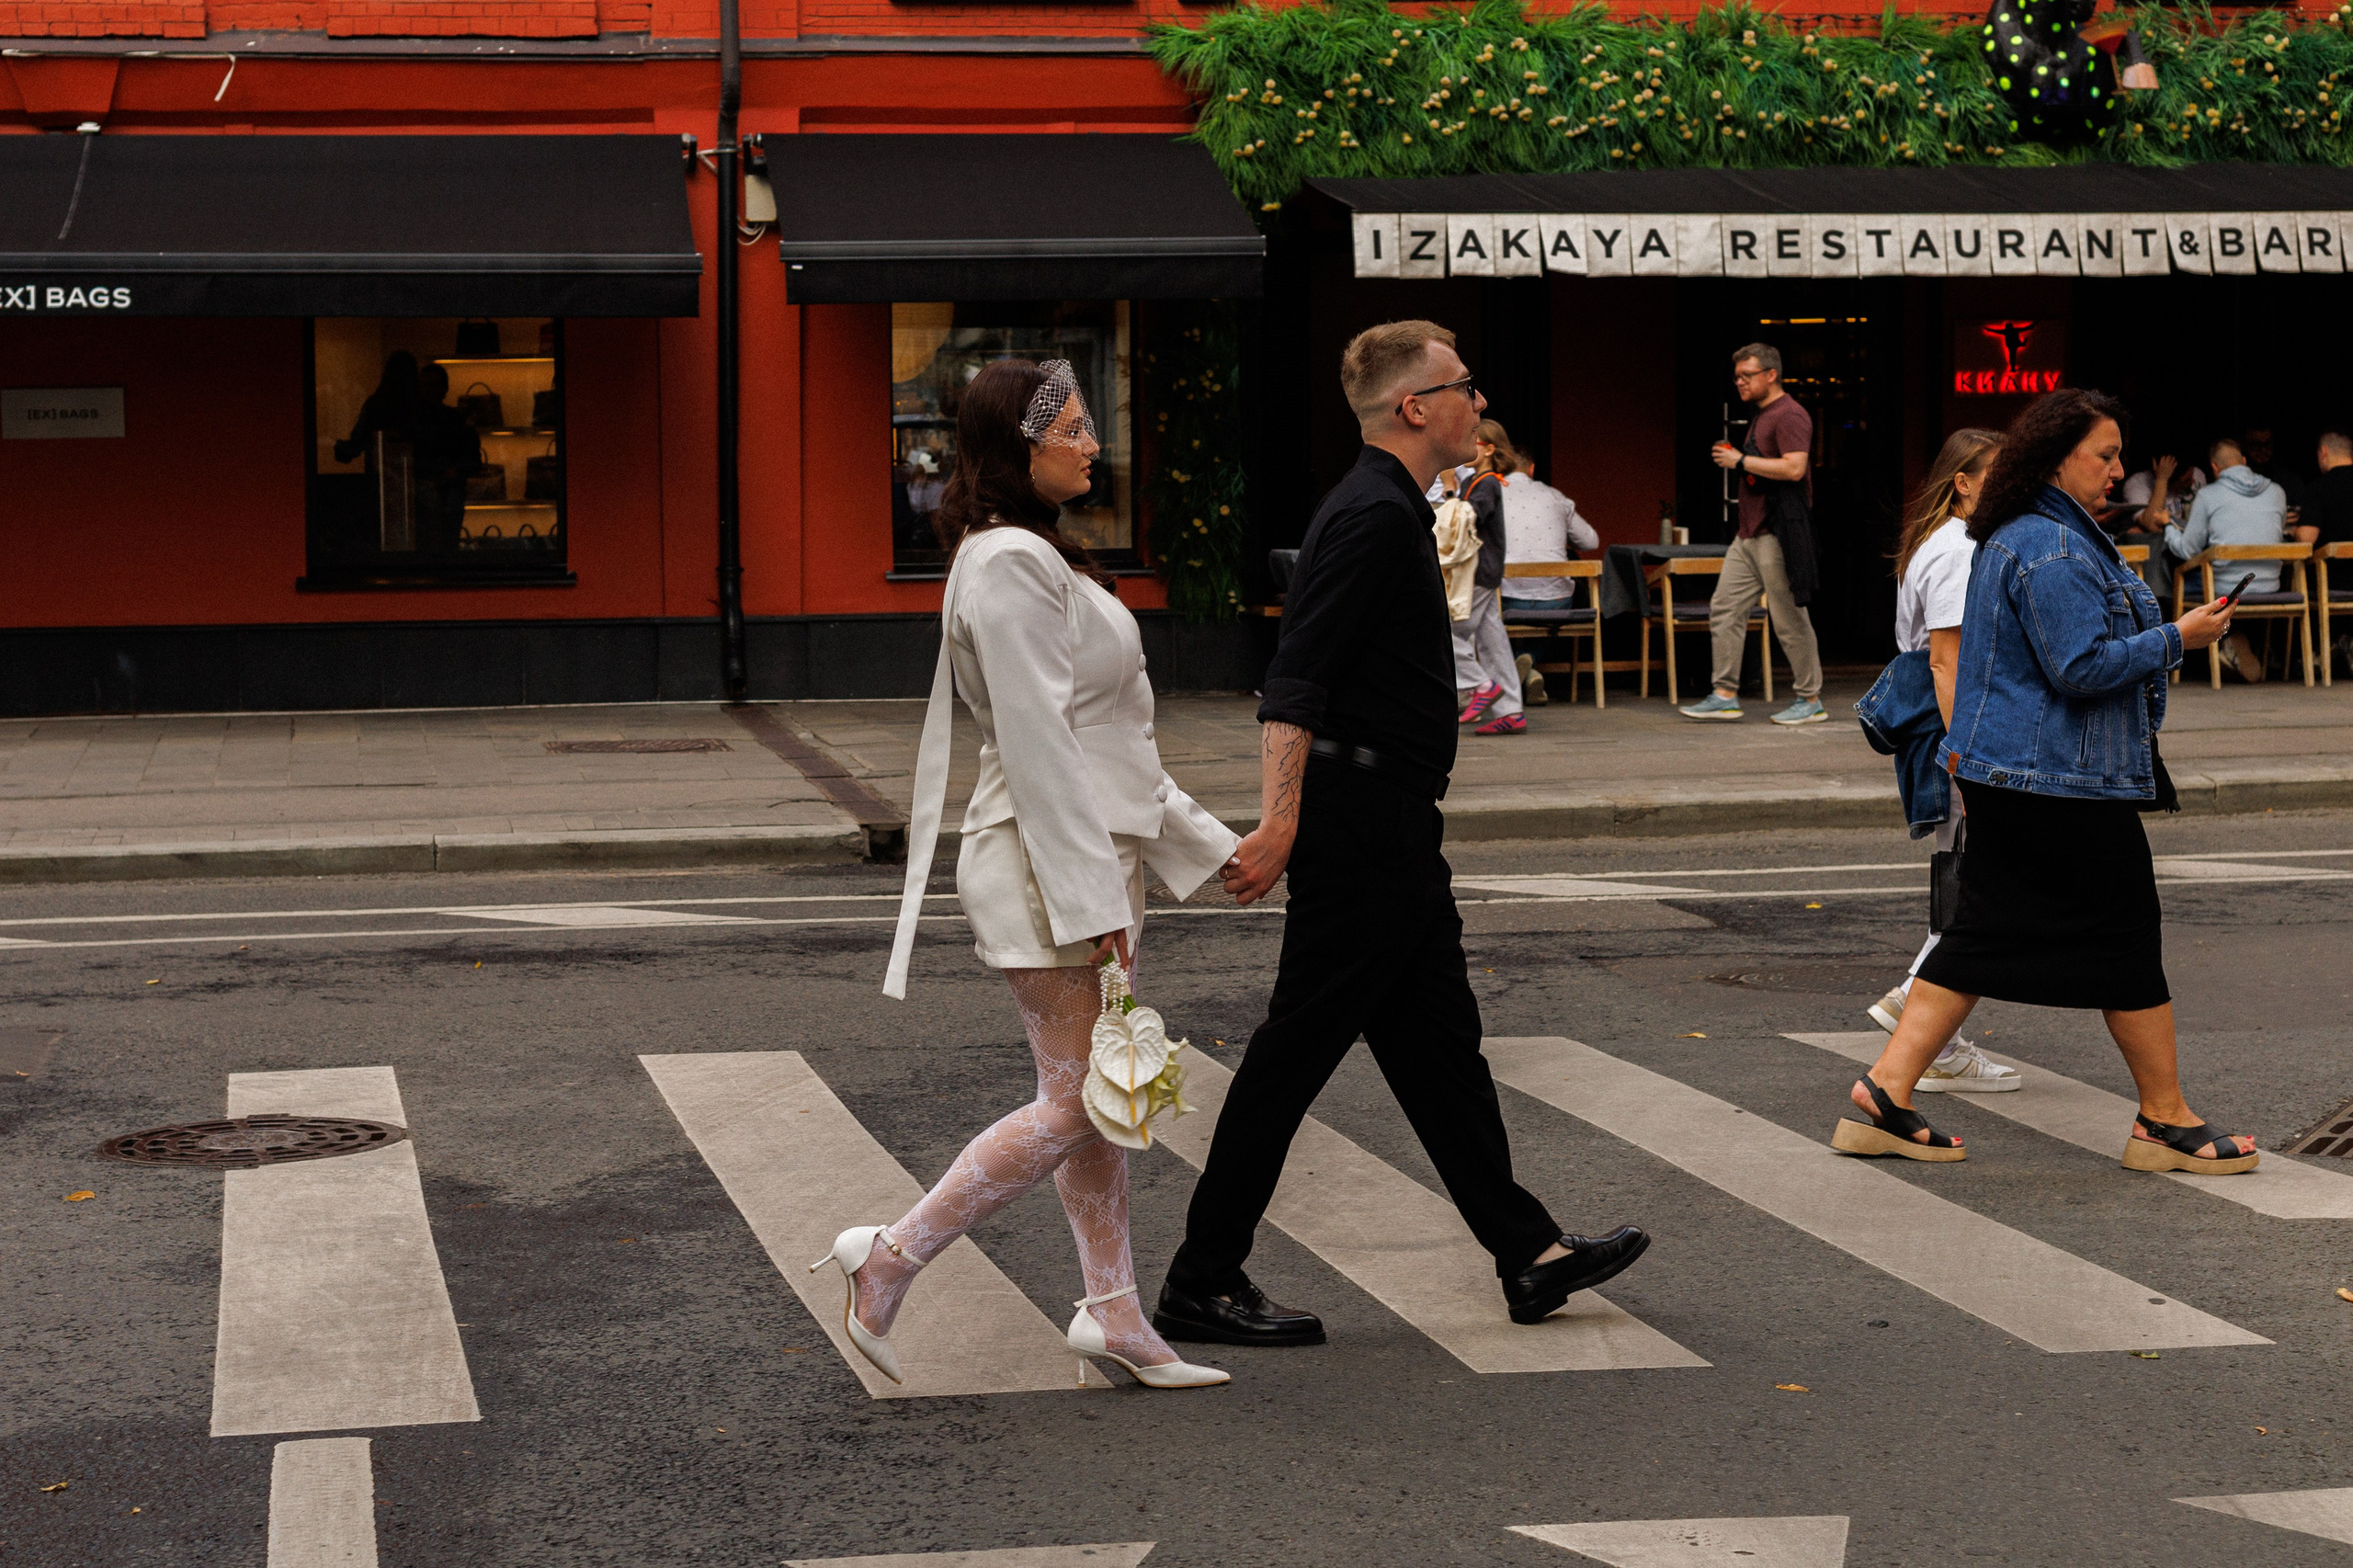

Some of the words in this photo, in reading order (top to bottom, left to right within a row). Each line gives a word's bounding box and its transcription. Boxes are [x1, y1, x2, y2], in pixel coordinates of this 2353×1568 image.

[1372, 228, 1671, 260] IZAKAYA
[0, 285, 36, 310] X]
[46, 287, 131, 309] BAGS
[1955, 370, 2061, 393] КИАНУ
[28, 408, 56, 419] [EX]
[60, 409, 98, 419] BAGS
